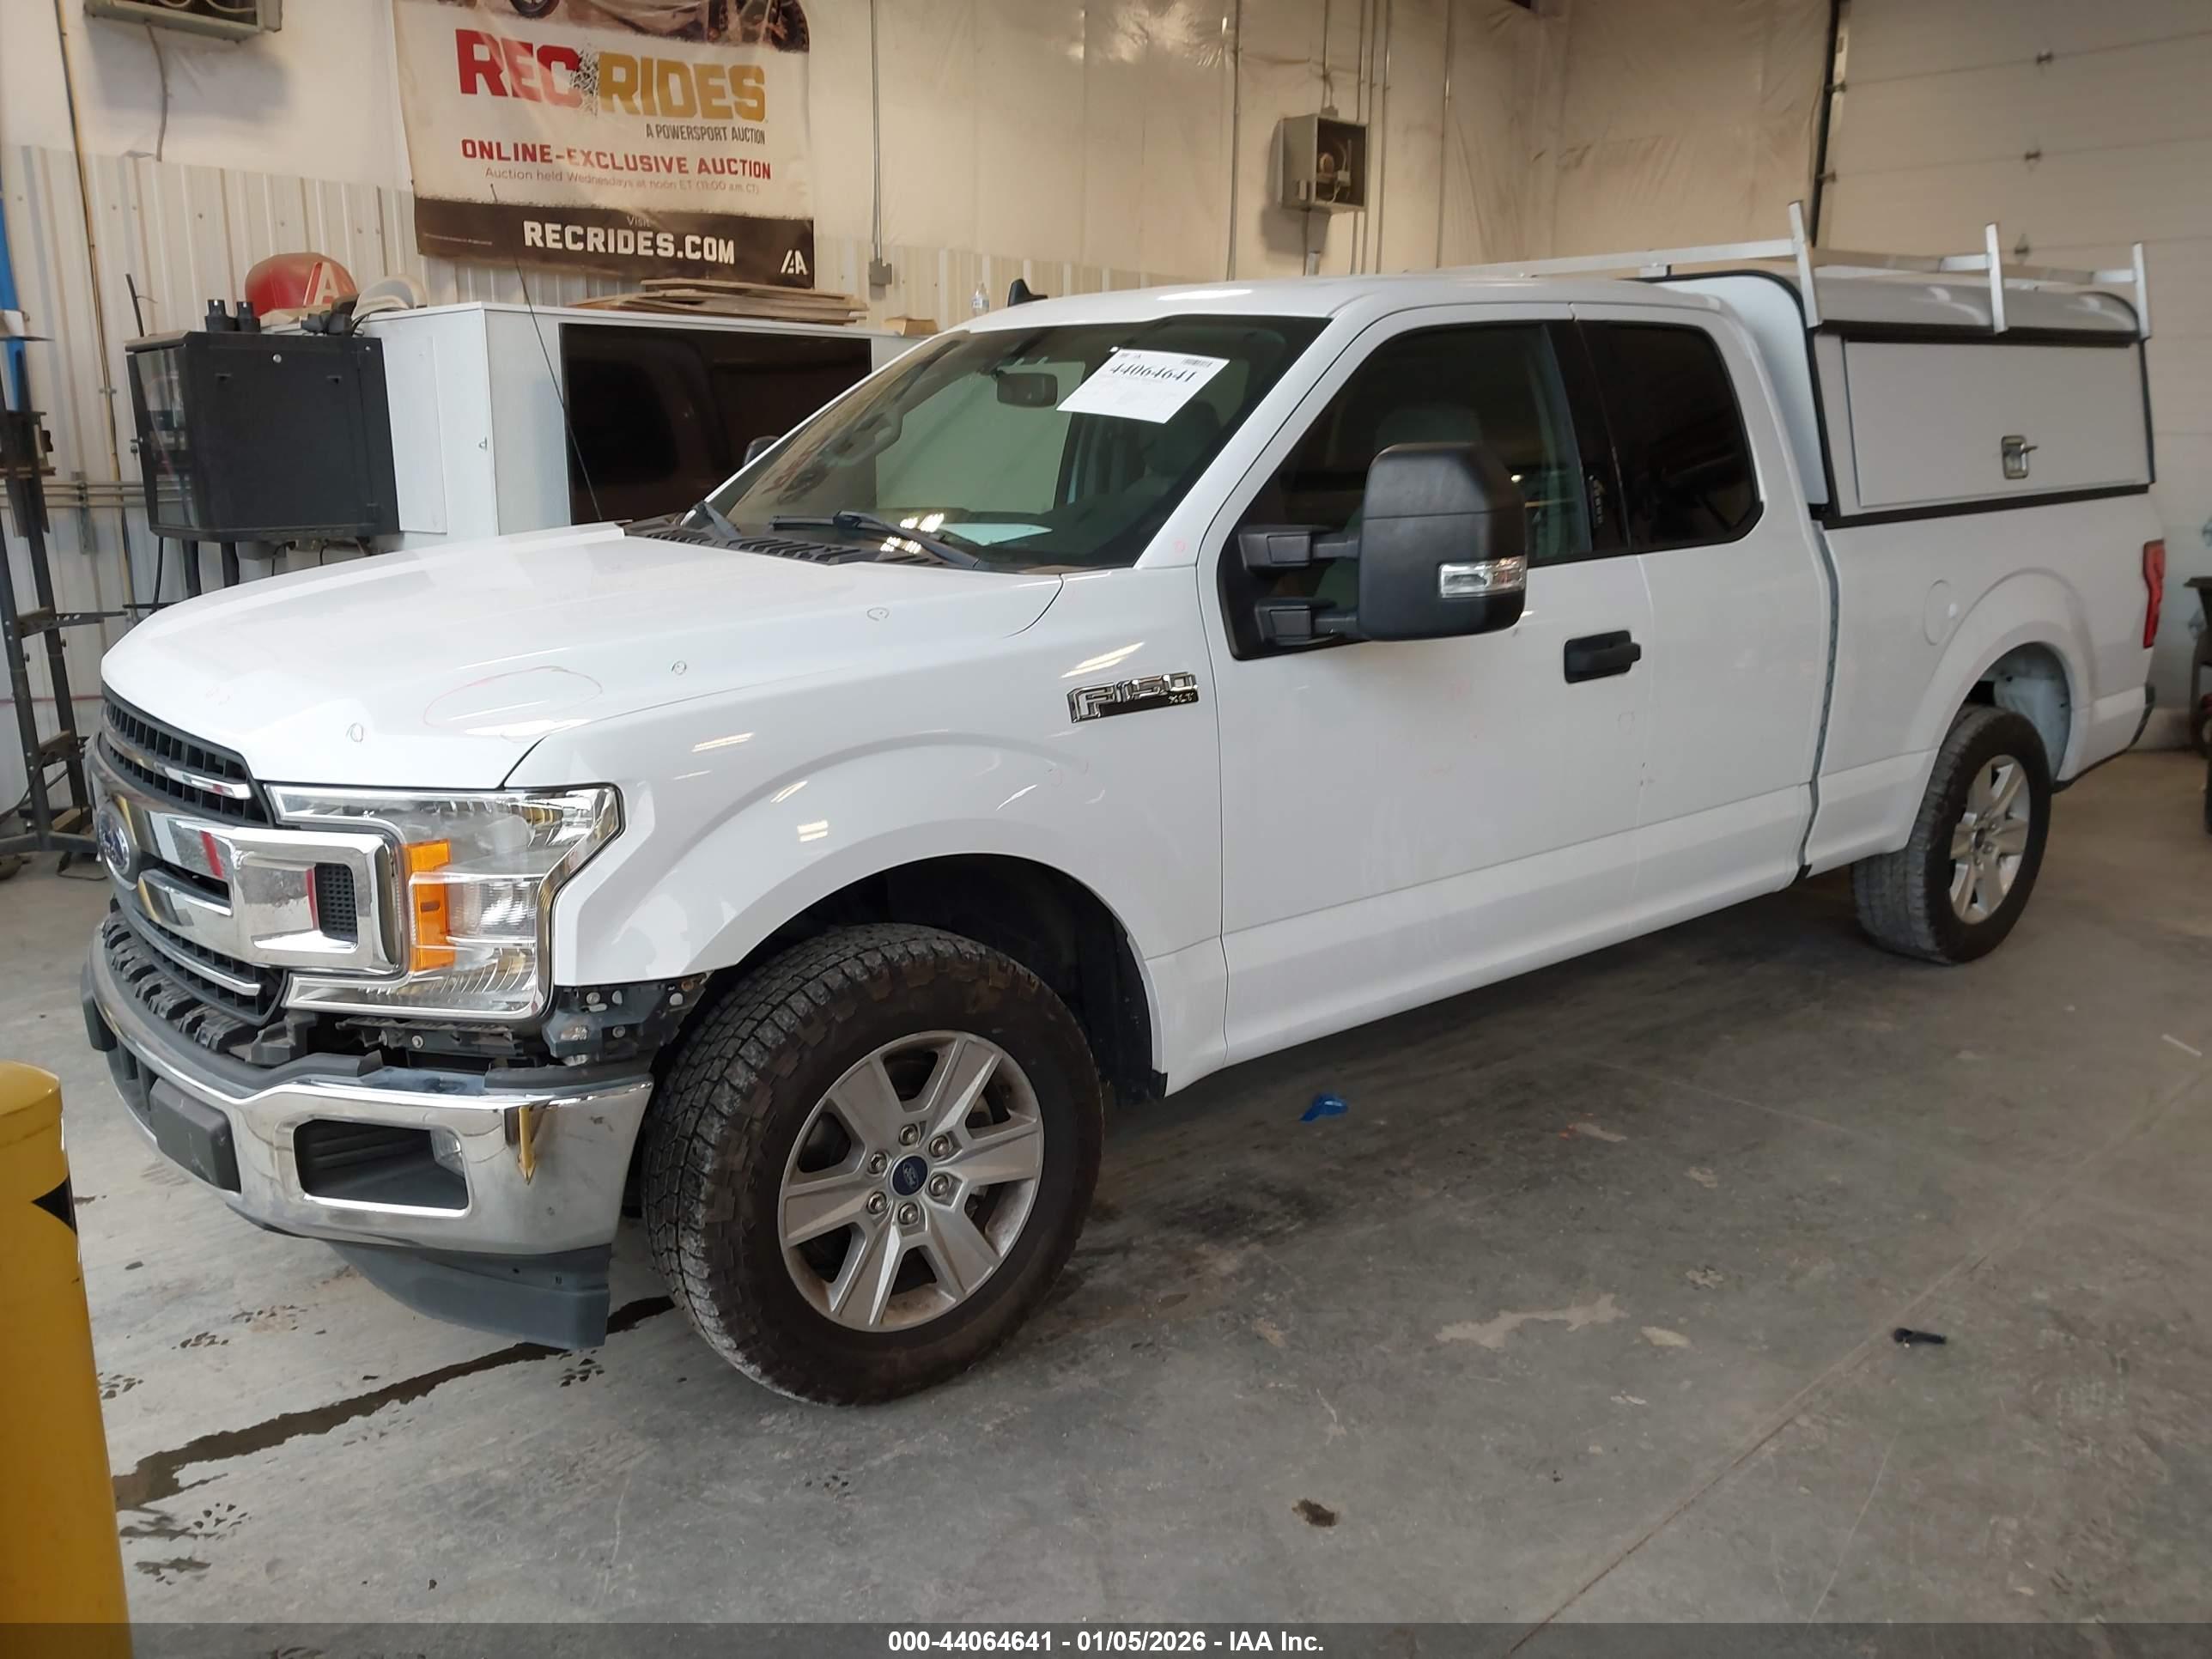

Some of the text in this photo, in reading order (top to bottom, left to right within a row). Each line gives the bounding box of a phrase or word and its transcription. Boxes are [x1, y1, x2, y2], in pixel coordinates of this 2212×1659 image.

[646, 124, 765, 145] A POWERSPORT AUCTION
[461, 138, 771, 179] ONLINE-EXCLUSIVE AUCTION
[485, 167, 532, 181] Auction
[537, 170, 562, 182] held
[567, 171, 634, 189] Wednesdays
[649, 178, 677, 191] noon
[627, 215, 650, 227] Visit
[523, 220, 735, 264] RECRIDES.COM
[1109, 362, 1197, 383] 44064641
